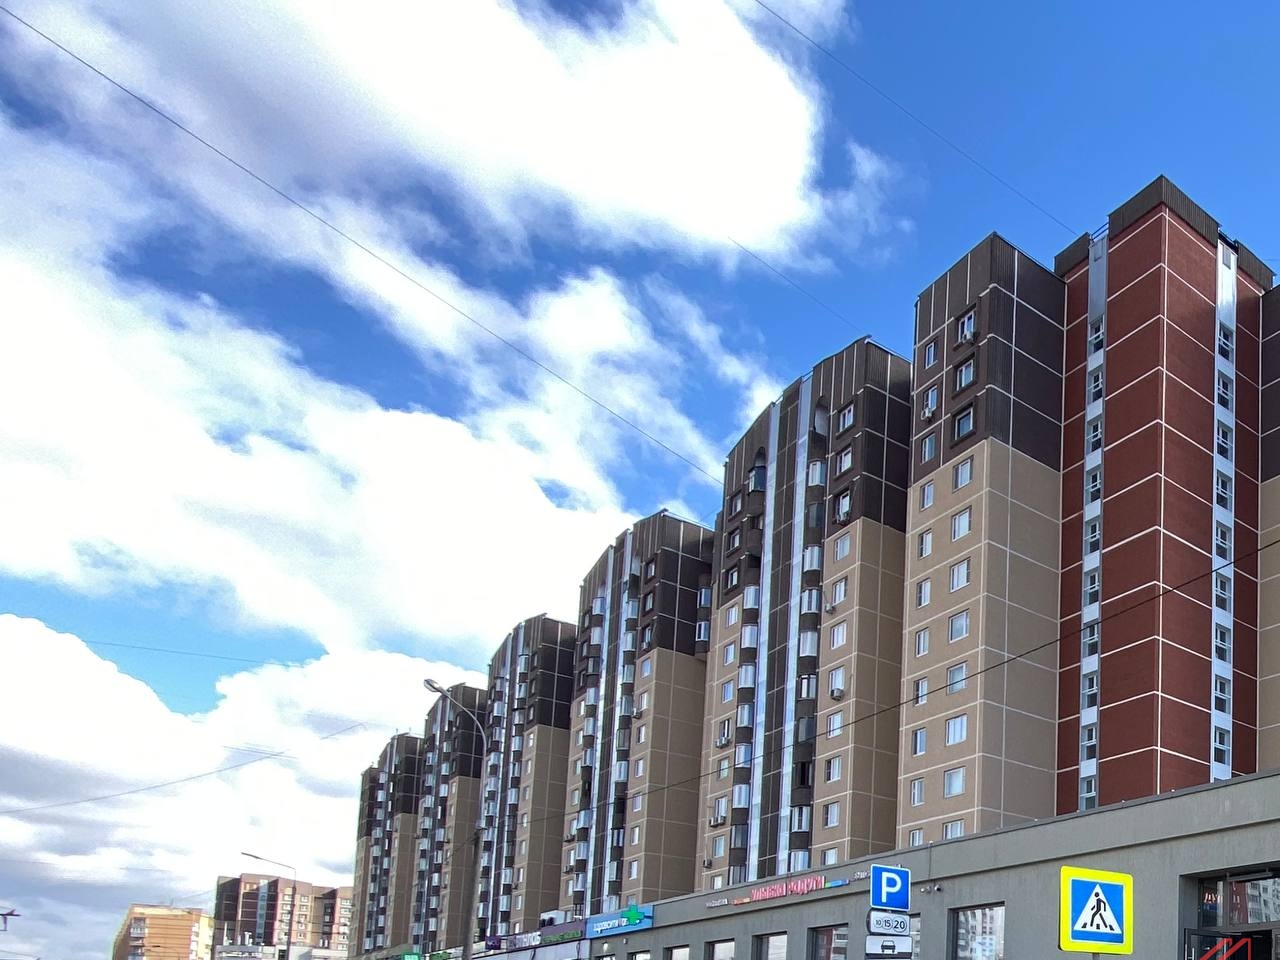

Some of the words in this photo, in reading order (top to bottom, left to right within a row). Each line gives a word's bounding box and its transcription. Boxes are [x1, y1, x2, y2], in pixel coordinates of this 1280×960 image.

[881, 871, 902, 903] P
[884, 919, 891, 928] 15
[893, 920, 905, 930] 20
